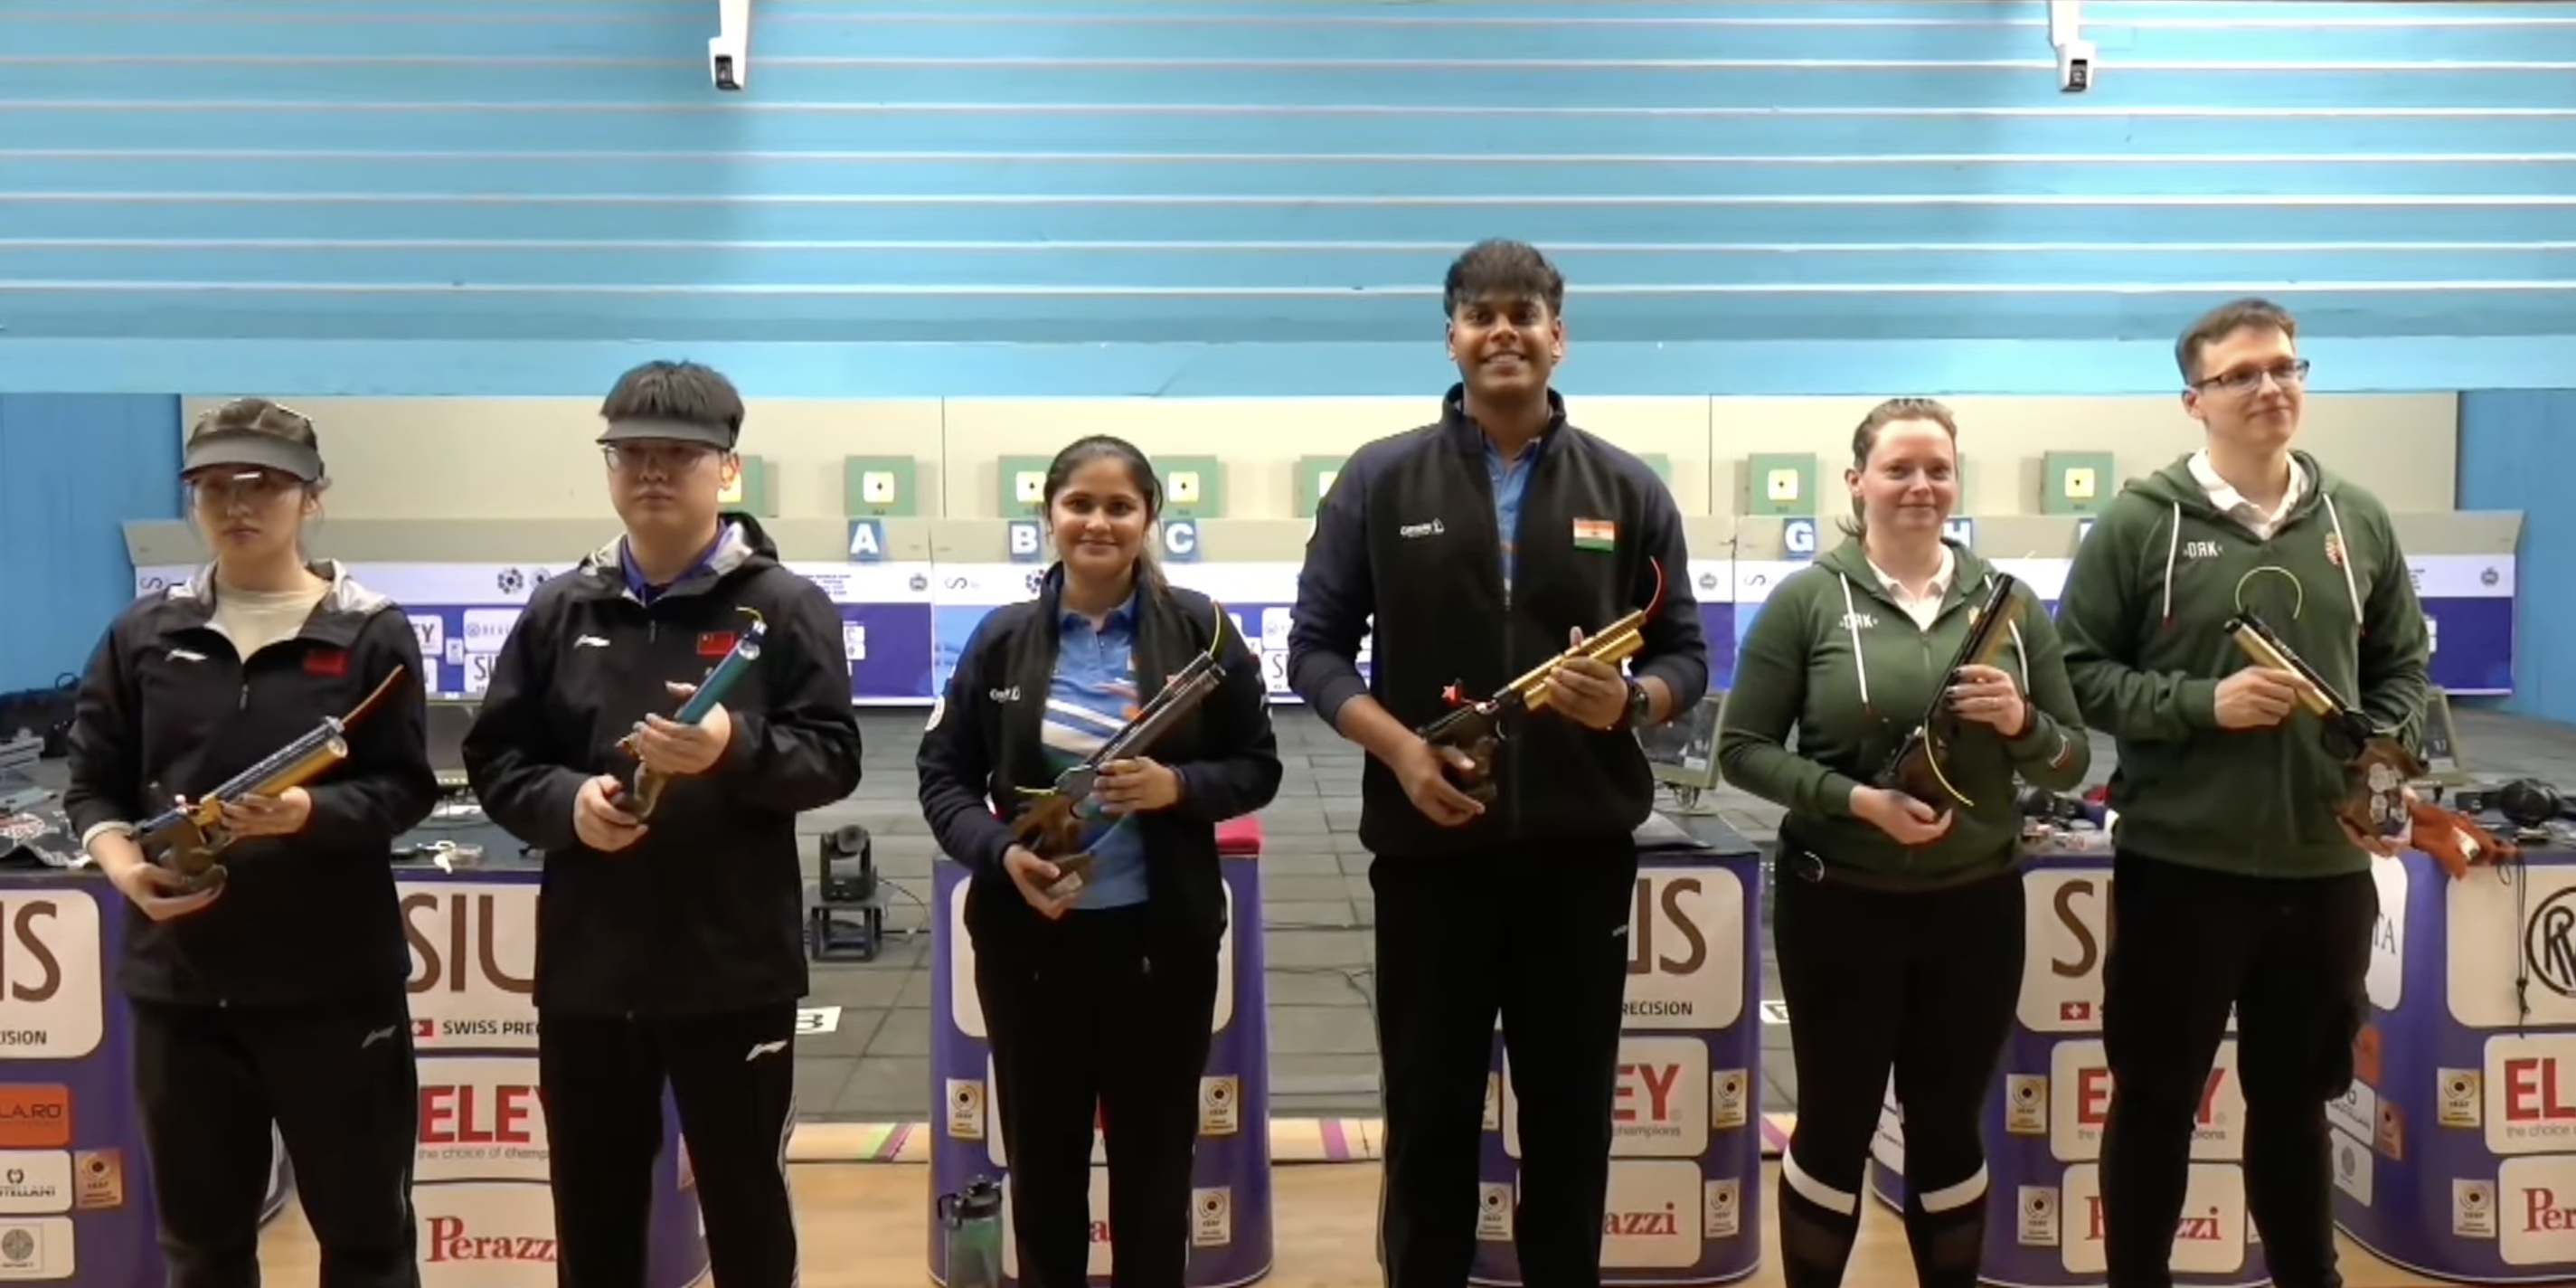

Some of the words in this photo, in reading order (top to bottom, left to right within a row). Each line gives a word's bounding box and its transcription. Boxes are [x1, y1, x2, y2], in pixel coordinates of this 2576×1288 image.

[849, 522, 879, 554] A
[1011, 524, 1038, 554] B
[1165, 522, 1195, 554] C
[1784, 520, 1815, 553] G
[442, 1020, 497, 1036] SWISS
[2529, 1122, 2570, 1138] choice
[442, 1146, 485, 1160] choice
[488, 1146, 501, 1159] of
